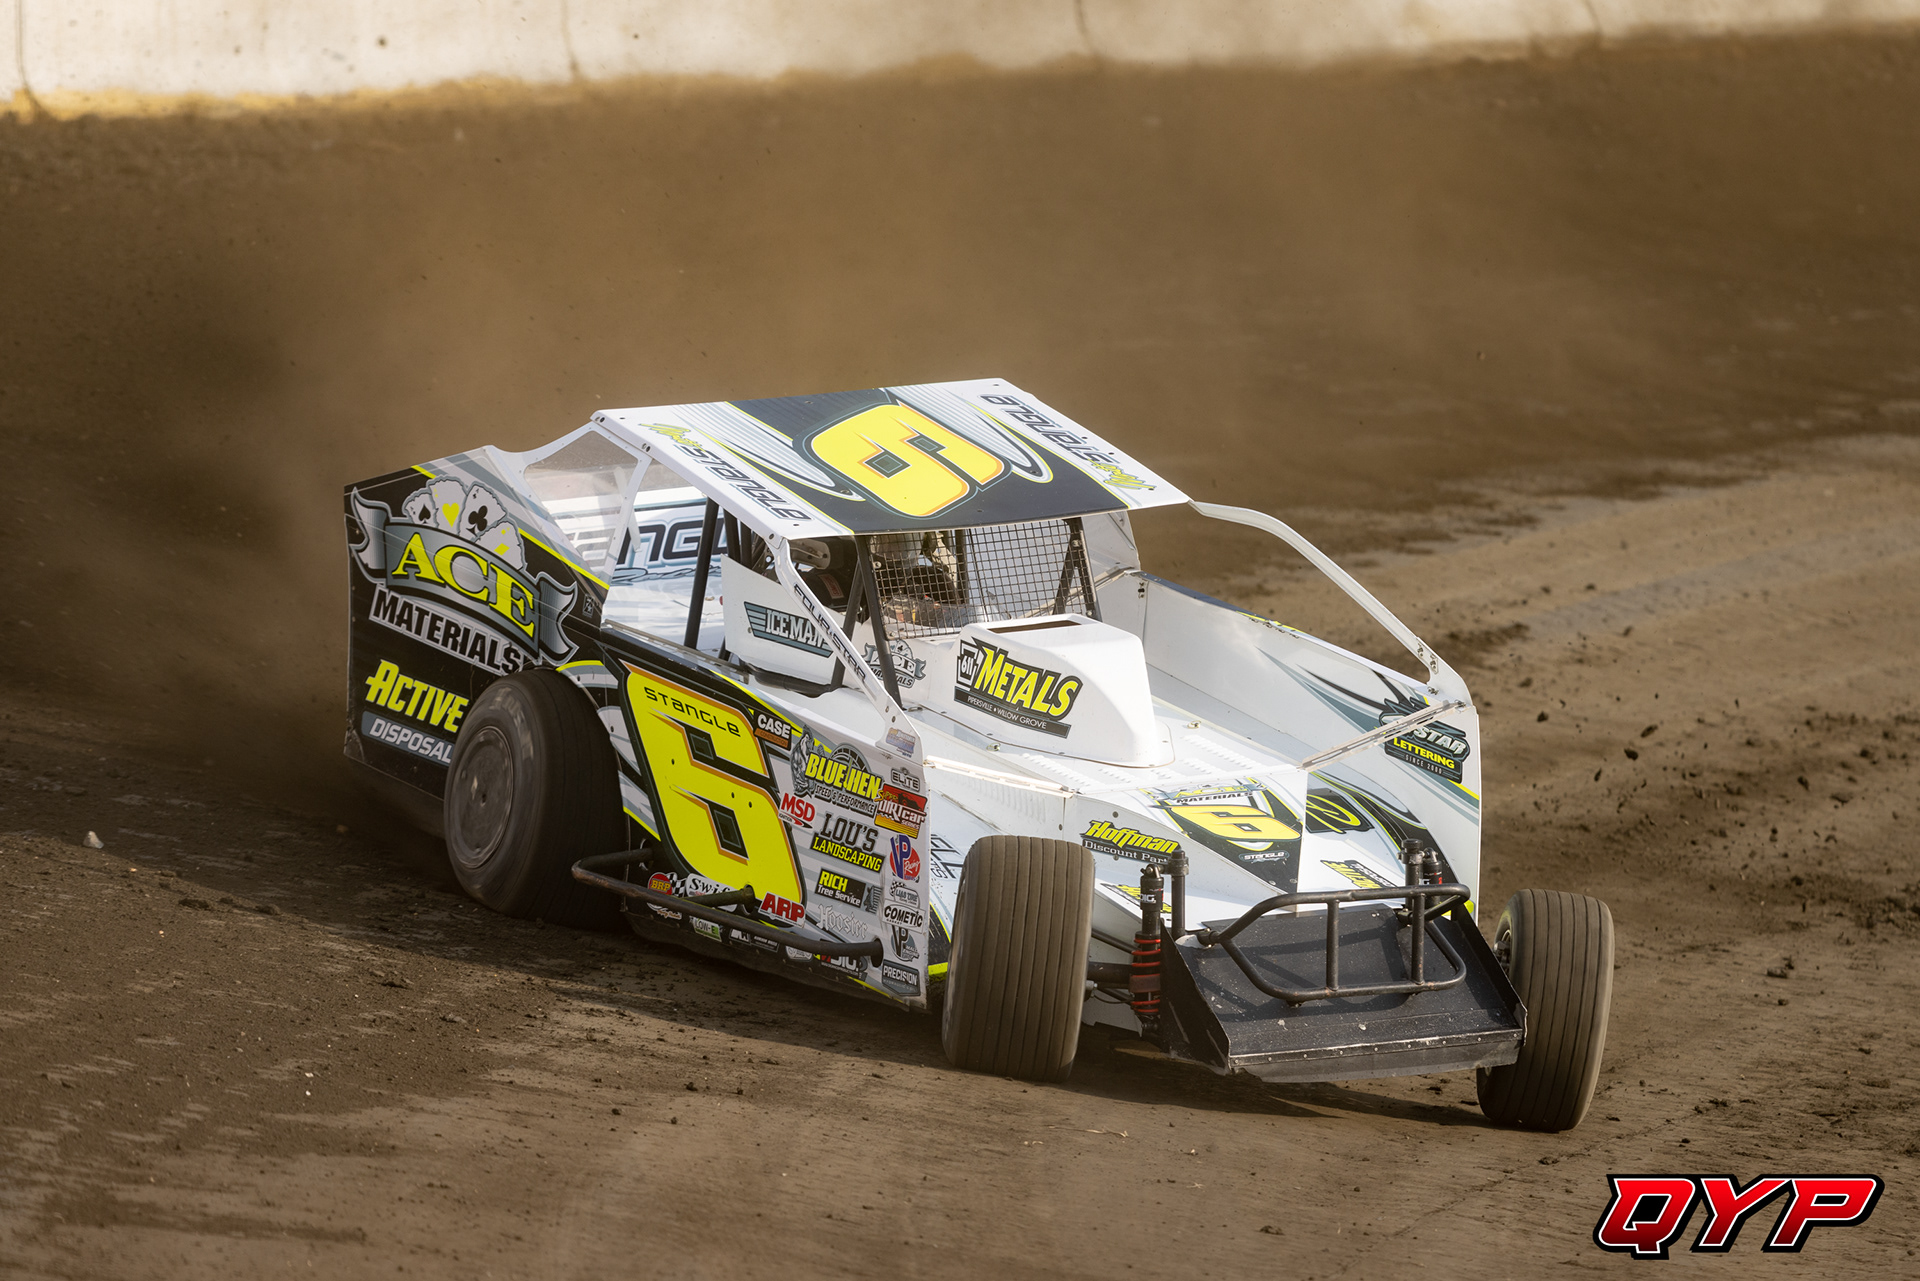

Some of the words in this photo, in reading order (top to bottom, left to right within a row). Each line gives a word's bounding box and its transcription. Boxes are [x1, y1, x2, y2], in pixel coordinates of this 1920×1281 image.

[811, 404, 1004, 516] 6
[391, 532, 534, 638] ACE
[371, 588, 524, 676] MATERIALS
[765, 608, 825, 648] ICEMAN
[365, 659, 470, 733] ACTIVE
[960, 655, 973, 676] 611
[973, 647, 1079, 717] METALS
[757, 713, 791, 740] CASE
[967, 695, 993, 712] PIPERSVILLE
[997, 707, 1018, 721] WILLOW
[1019, 715, 1047, 730] GROVE
[369, 717, 452, 764] DISPOSAL
[1393, 737, 1455, 769] LETTERING
[1413, 725, 1467, 755] STAR
[804, 752, 848, 789] BLUE
[846, 767, 882, 801] HEN
[1404, 754, 1424, 768] SINCE
[1427, 763, 1442, 775] 2000
[626, 668, 802, 906] 6
[815, 784, 832, 798] SPEED
[838, 790, 876, 815] PERFORMANCE
[1172, 785, 1249, 799] ACE
[1176, 791, 1254, 804] MATERIALS
[780, 792, 816, 822] MSD
[1170, 805, 1301, 840] 6
[820, 812, 880, 853] LOU'S
[1084, 820, 1179, 854] Hoffman
[812, 836, 883, 872] LANDSCAPING
[1084, 840, 1138, 860] Discount
[1141, 851, 1168, 864] Part
[650, 879, 671, 892] BRP
[817, 884, 834, 897] Tree
[834, 889, 861, 906] Service
[818, 870, 849, 893] RICH
[760, 892, 805, 924] ARP
[815, 903, 869, 940] Hoosier
[884, 905, 923, 928] COMETIC
[882, 965, 919, 986] PRECISION
